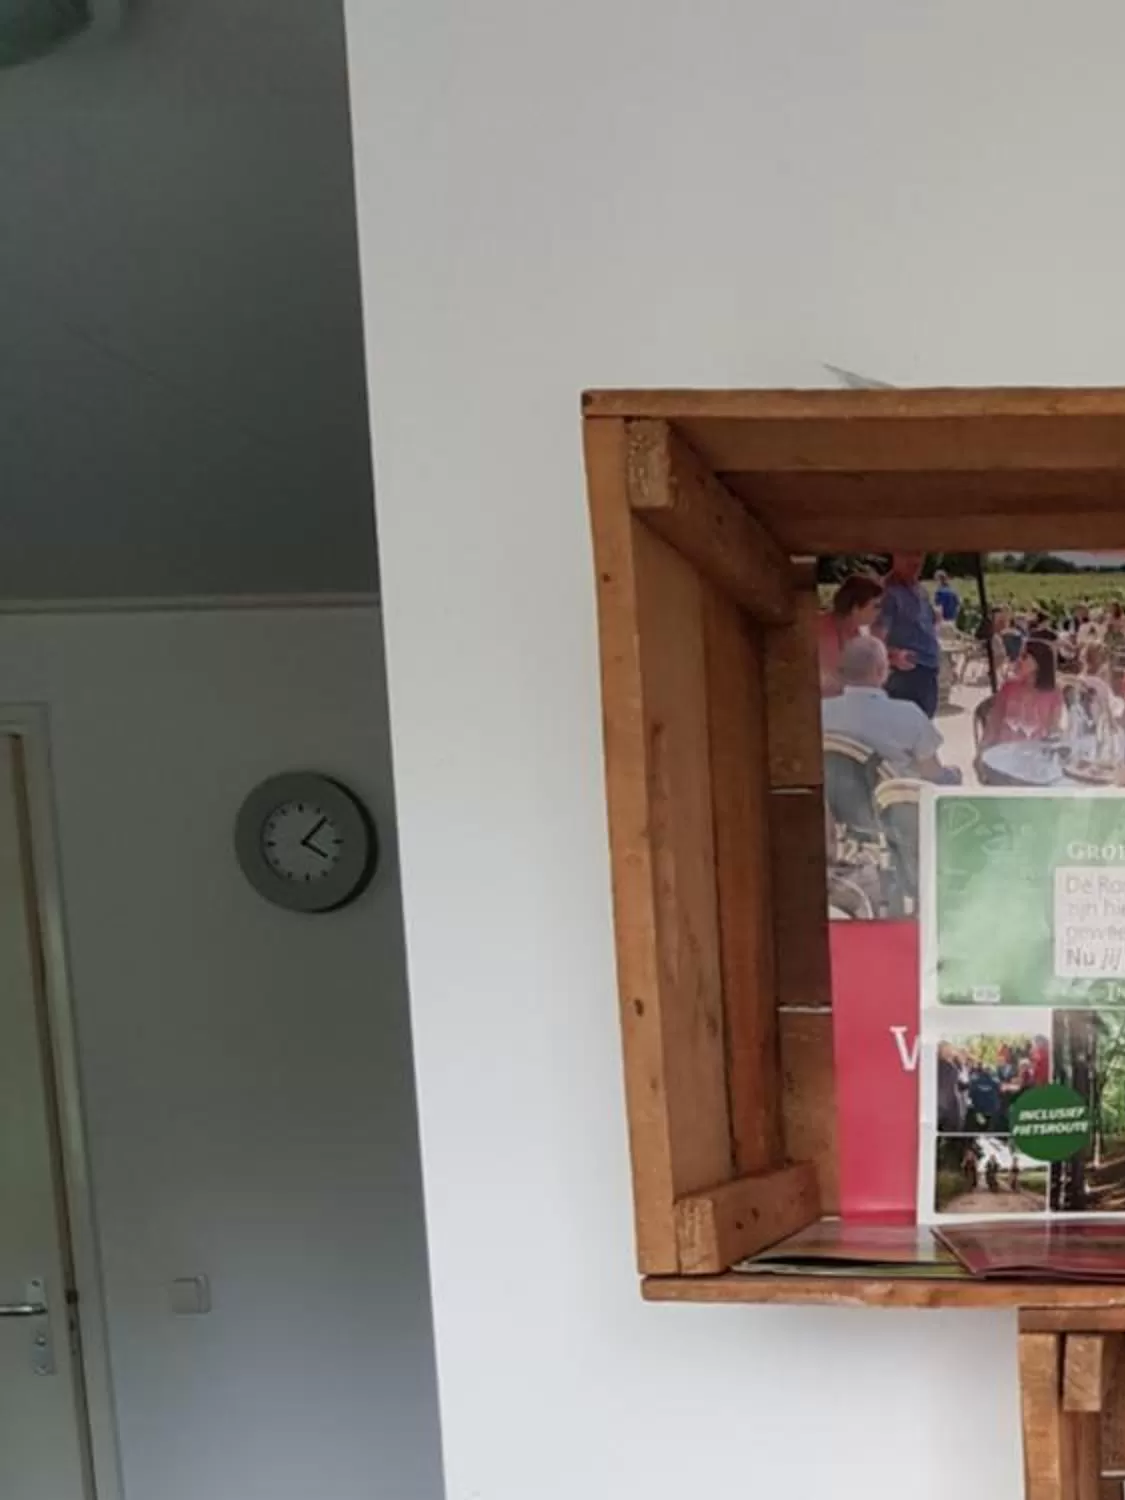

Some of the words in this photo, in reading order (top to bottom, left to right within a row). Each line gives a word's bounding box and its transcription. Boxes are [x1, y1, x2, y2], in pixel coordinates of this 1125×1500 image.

[1065, 948, 1096, 968] Nu
[1018, 1106, 1087, 1121] INCLUSIEF
[1012, 1120, 1090, 1136] FIETSROUTE
